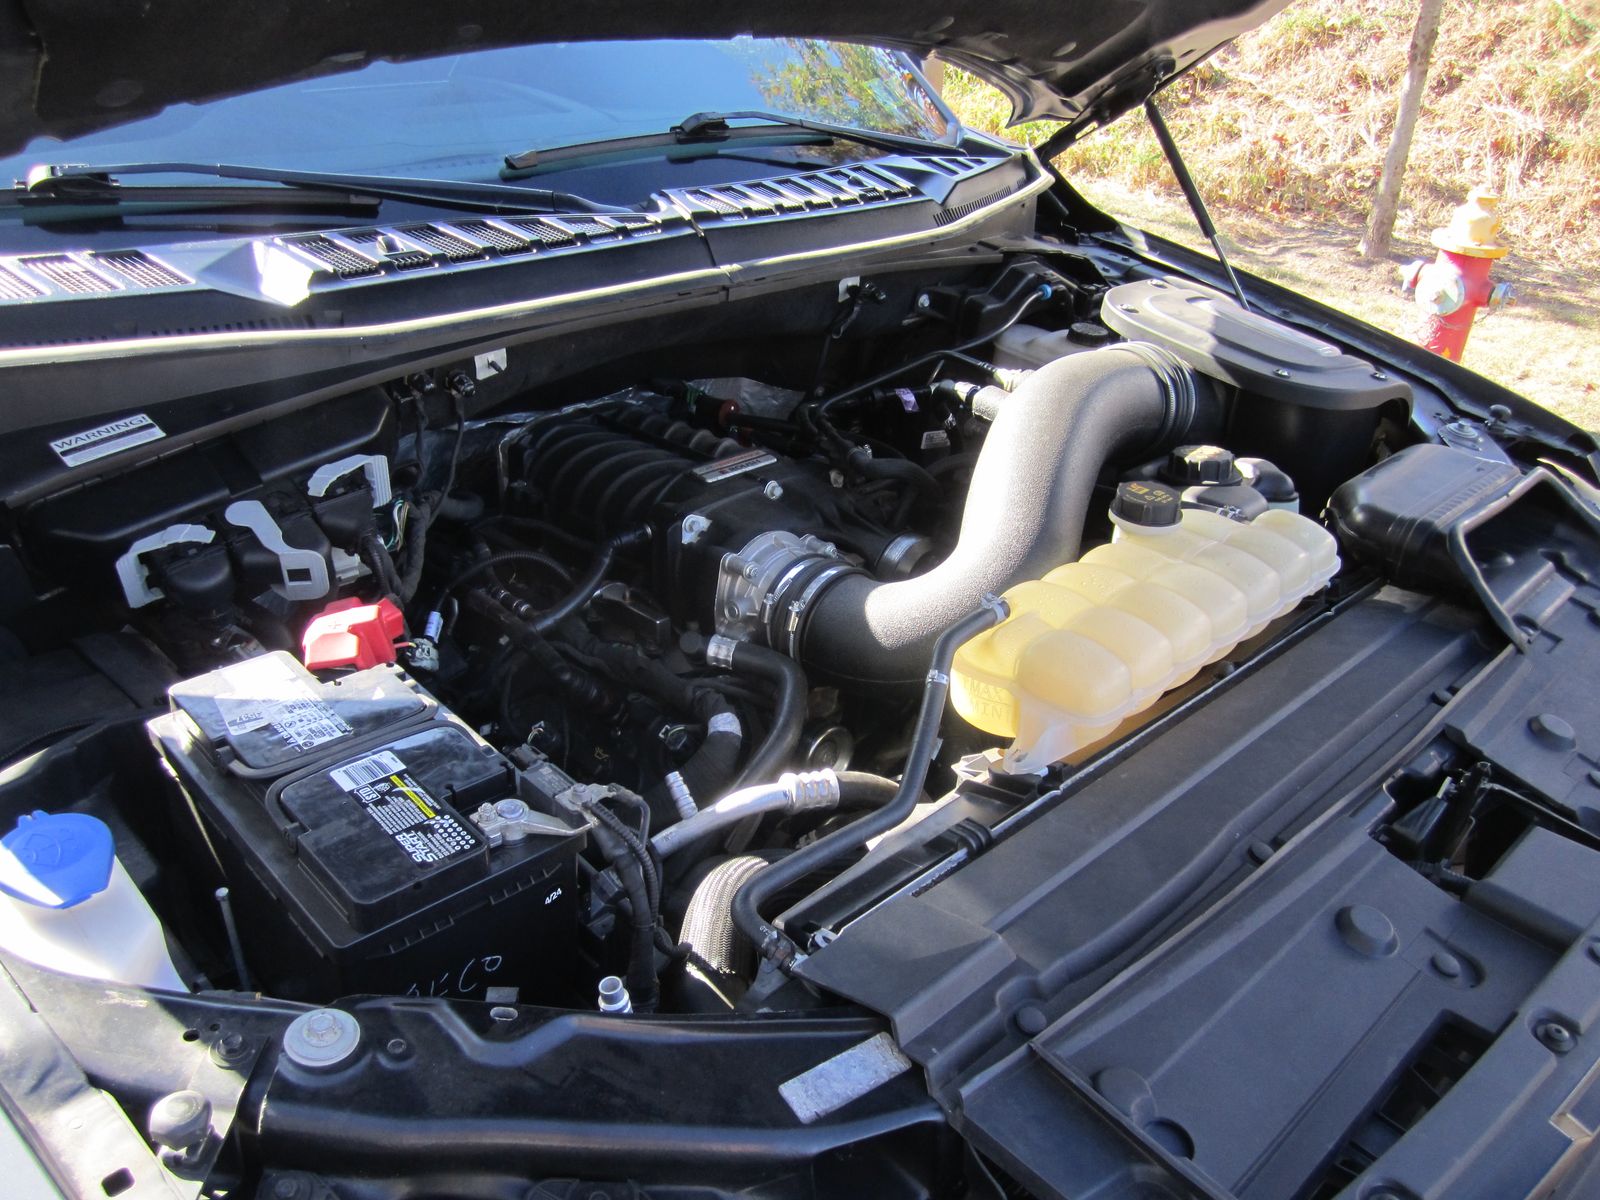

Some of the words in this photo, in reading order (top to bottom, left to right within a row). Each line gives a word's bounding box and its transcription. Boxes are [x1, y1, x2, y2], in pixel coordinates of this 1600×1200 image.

[54, 415, 148, 449] WARNING!
[395, 834, 422, 862] SUPER
[402, 831, 438, 862] START
